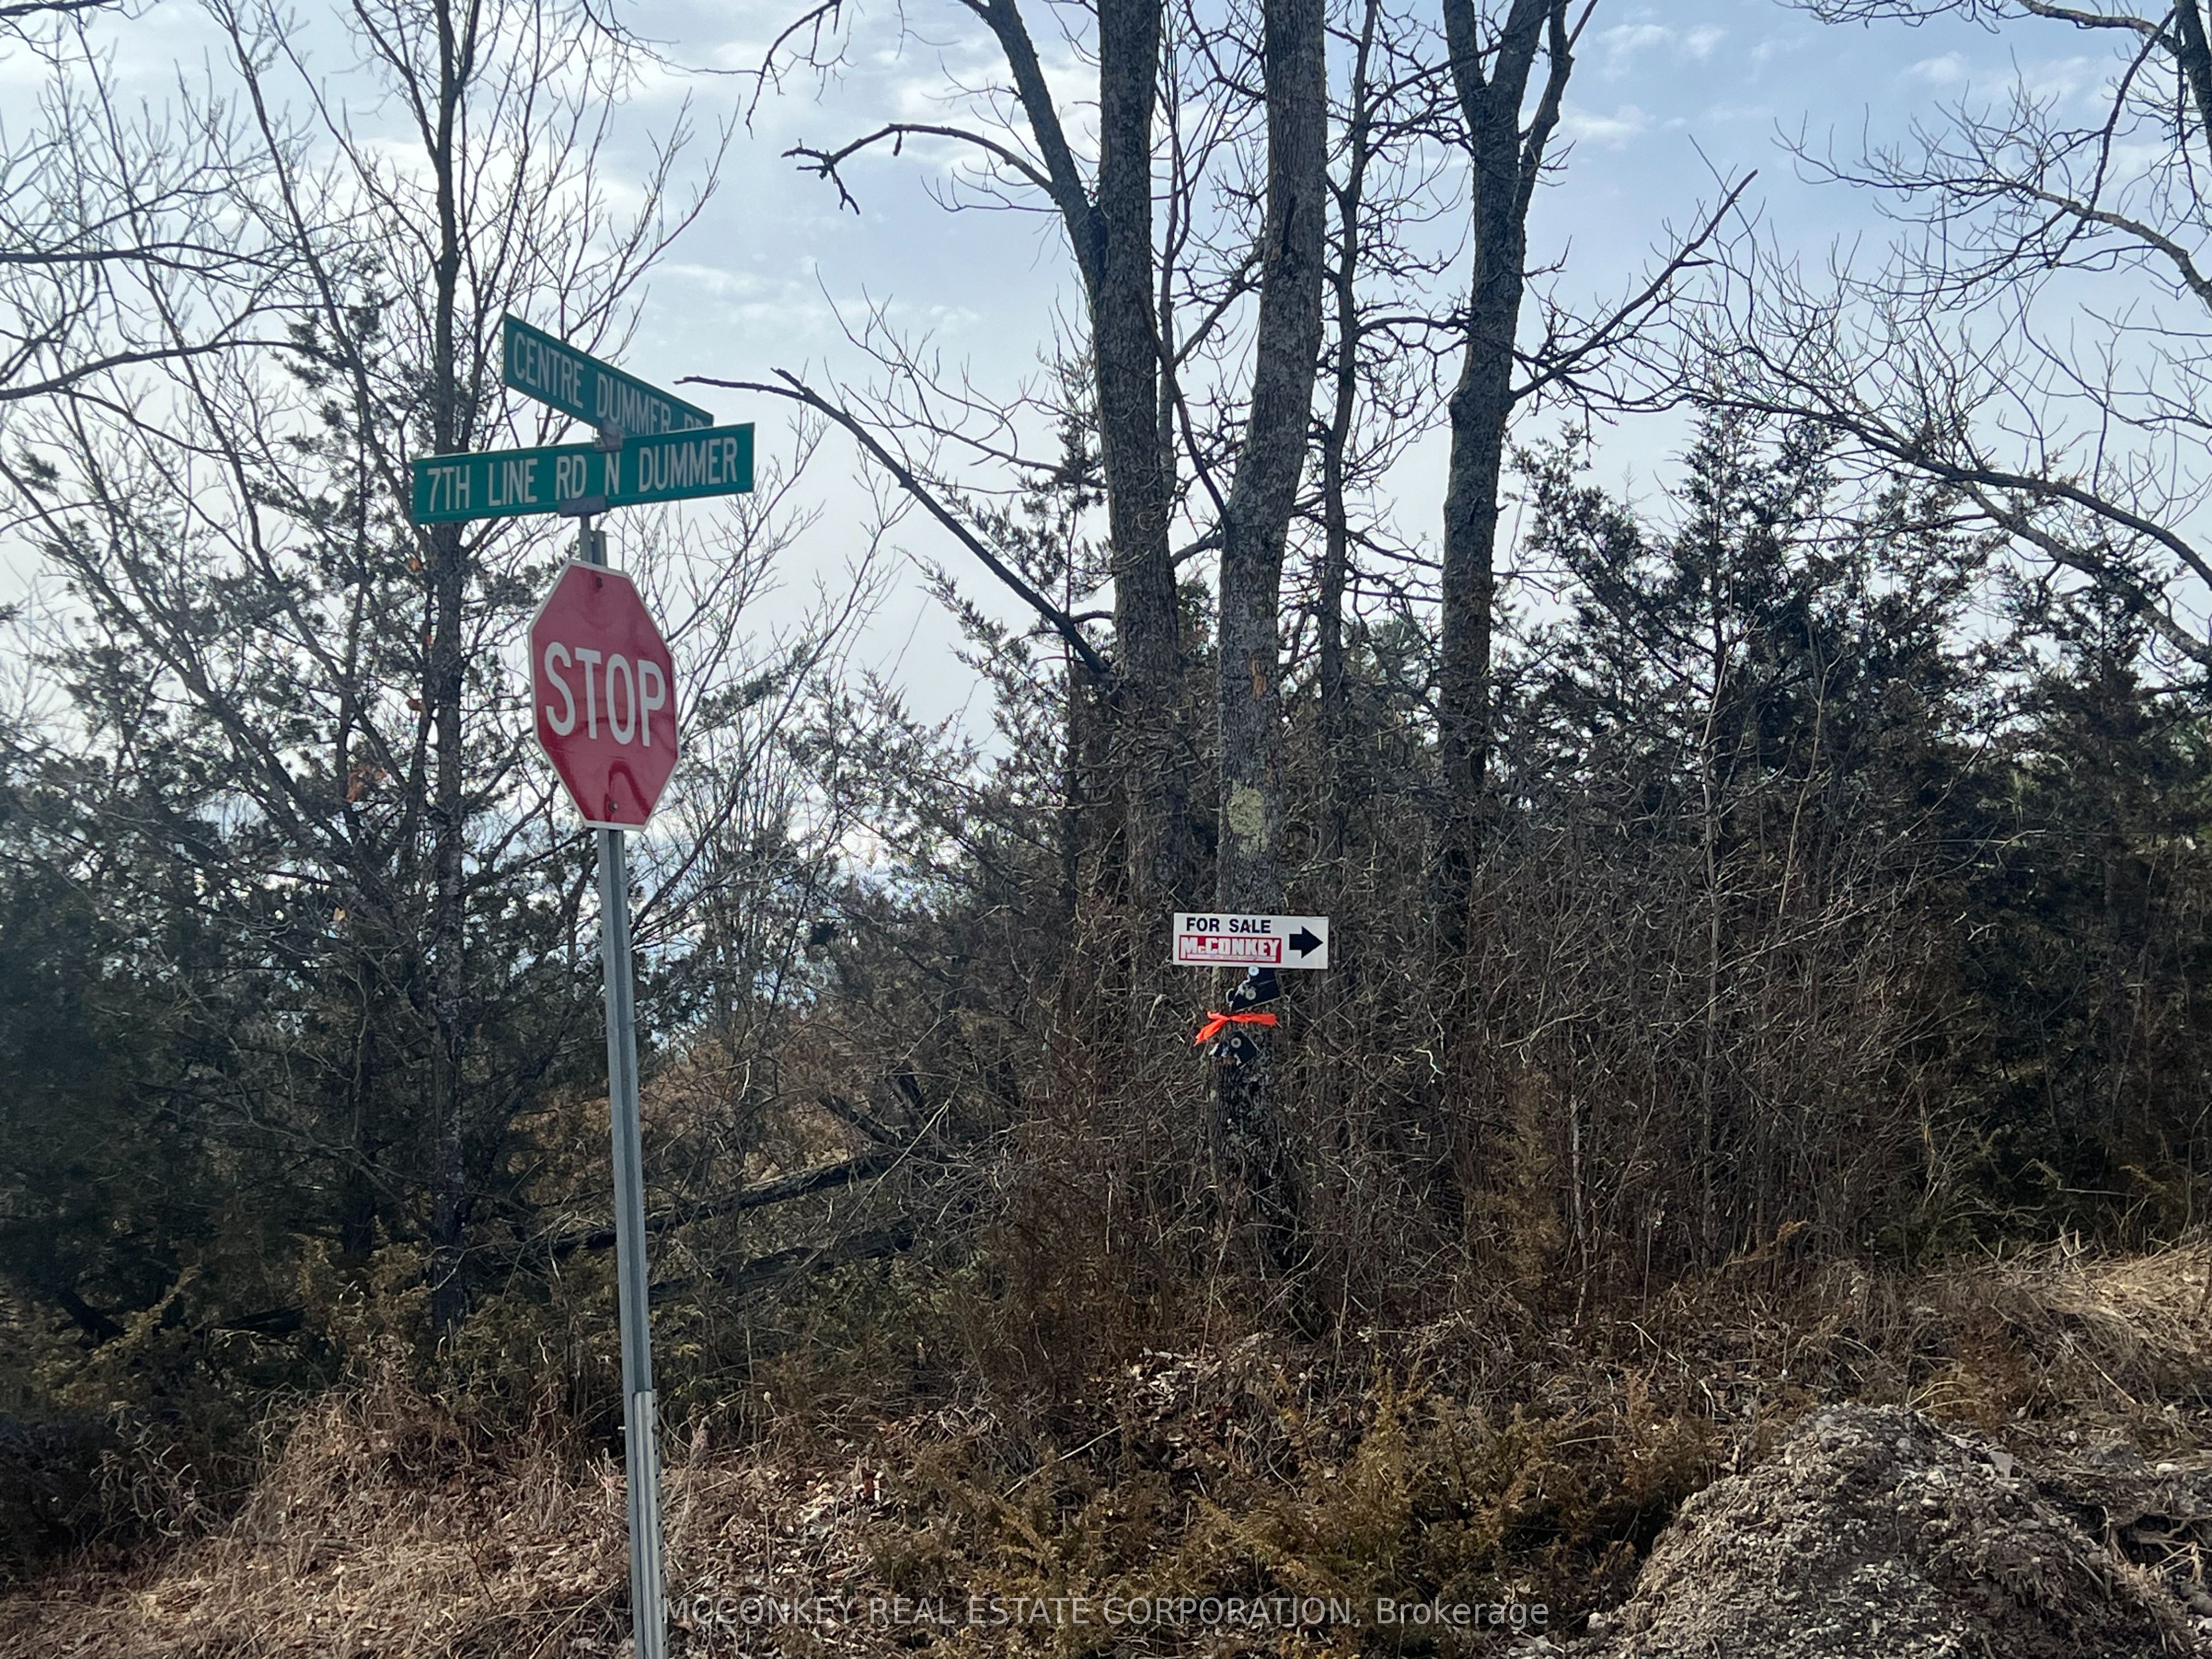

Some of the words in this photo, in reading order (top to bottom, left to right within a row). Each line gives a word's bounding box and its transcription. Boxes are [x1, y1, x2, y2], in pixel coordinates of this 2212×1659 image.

[514, 332, 585, 409] CENTRE
[596, 372, 672, 435] DUMMER
[427, 468, 471, 512] 7TH
[488, 459, 538, 507] LINE
[555, 454, 587, 499] RD
[605, 452, 620, 495] N
[639, 437, 738, 494] DUMMER
[544, 642, 666, 747] STOP
[1186, 917, 1220, 932] FOR
[1229, 918, 1271, 934] SALE
